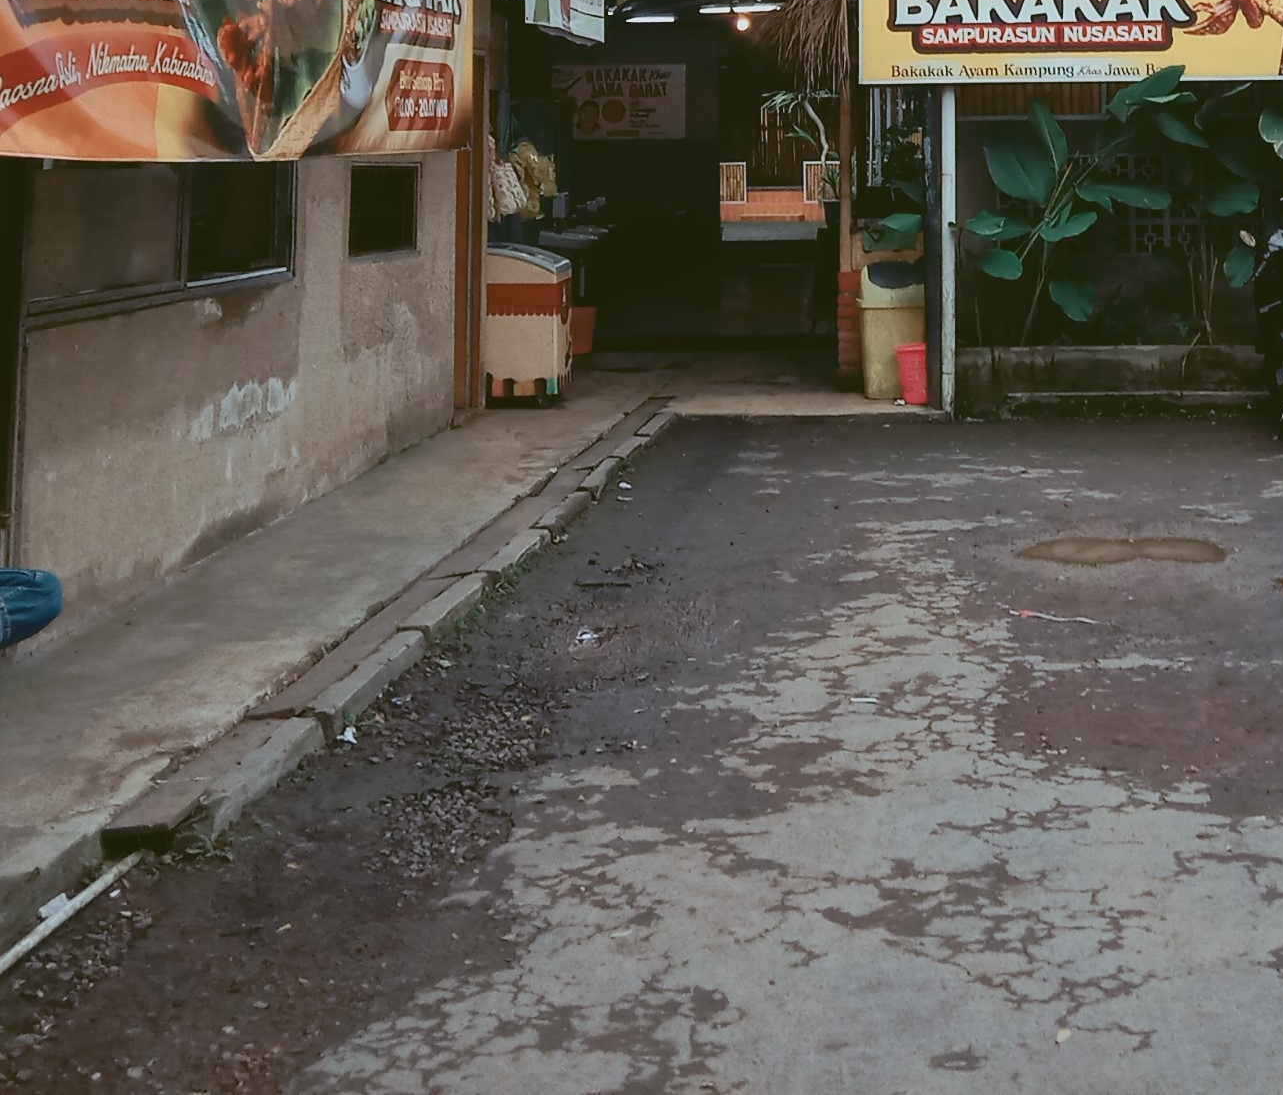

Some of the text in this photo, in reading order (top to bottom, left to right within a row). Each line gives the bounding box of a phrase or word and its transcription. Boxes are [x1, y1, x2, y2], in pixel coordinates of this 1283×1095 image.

[921, 25, 1162, 45] SAMPURASUN NUSASARI
[0, 74, 58, 112] aosna
[86, 41, 149, 79] Nikmatna
[891, 65, 953, 78] Bakakak
[959, 64, 999, 78] Ayam
[1004, 63, 1075, 78] Kampung
[1077, 65, 1102, 76] Khas
[1104, 64, 1140, 76] Jawa
